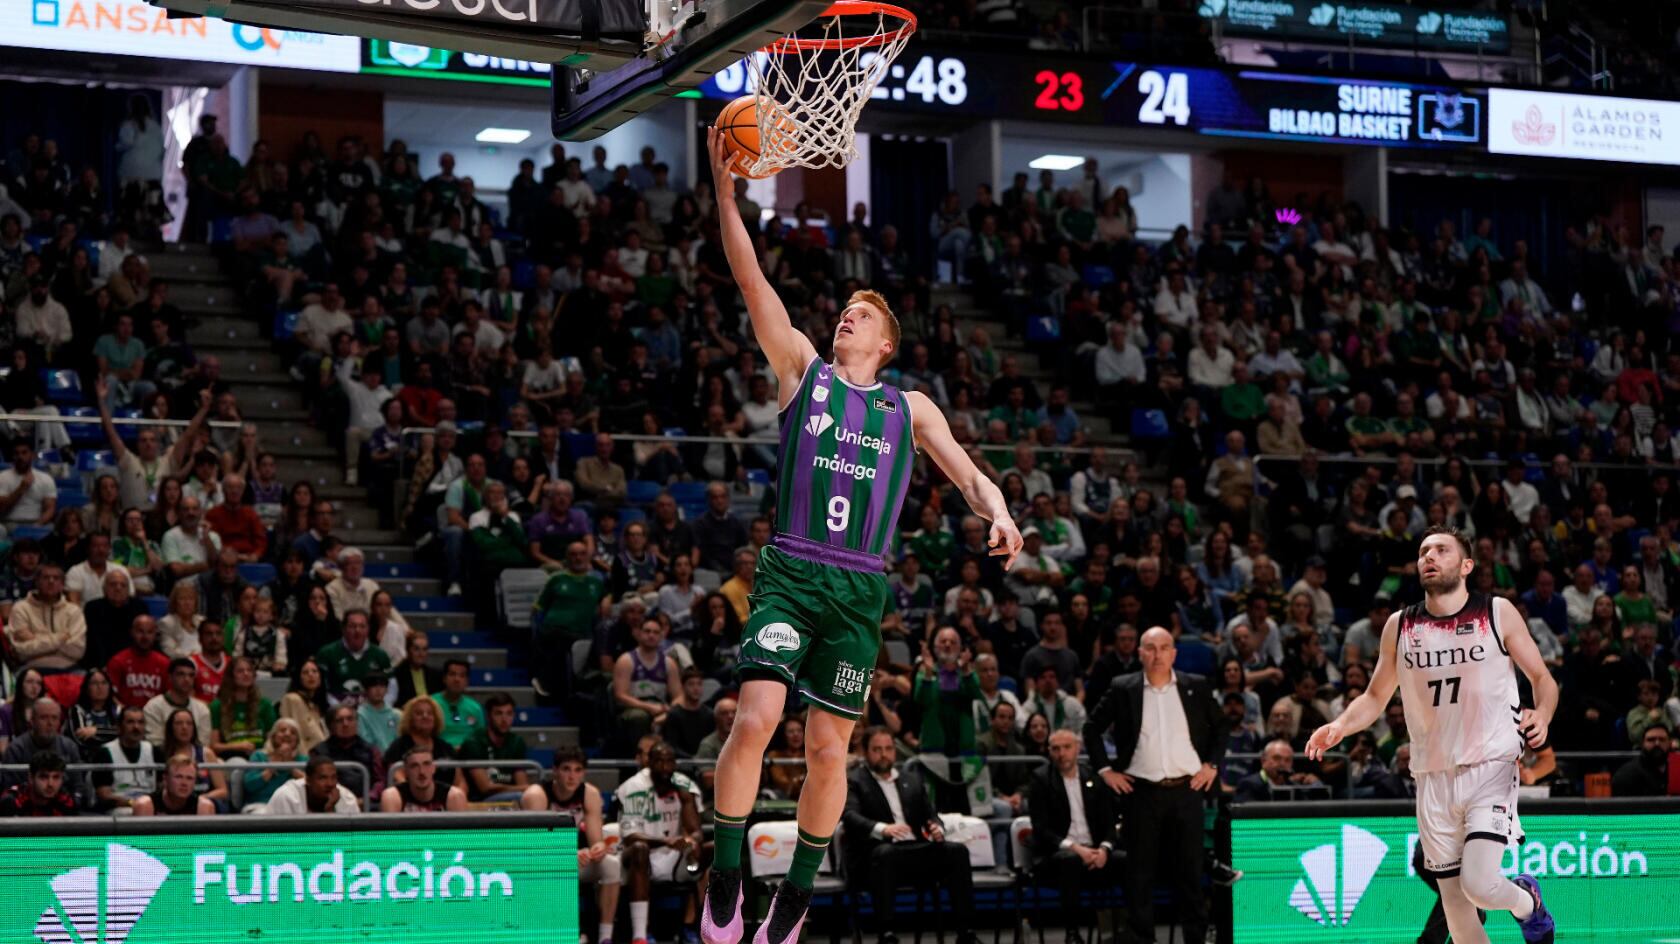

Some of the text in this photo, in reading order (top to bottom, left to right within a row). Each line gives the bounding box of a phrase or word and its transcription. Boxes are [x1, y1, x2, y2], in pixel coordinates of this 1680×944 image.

[65, 0, 207, 38] ANSAN
[859, 52, 967, 105] 2:48
[1035, 70, 1085, 111] 23
[1138, 70, 1190, 125] 24
[1338, 84, 1412, 115] SURNE
[1269, 108, 1412, 140] BILBAO BASKET
[1572, 121, 1662, 141] GARDEN
[834, 426, 892, 455] Unicaja
[813, 453, 877, 480] málaga
[826, 495, 851, 532] 9
[1404, 644, 1485, 670] surne
[126, 672, 161, 690] BAXI
[834, 672, 862, 693] laga
[1427, 676, 1462, 707] 77
[1407, 831, 1648, 877] dación
[192, 847, 515, 904] Fundación
